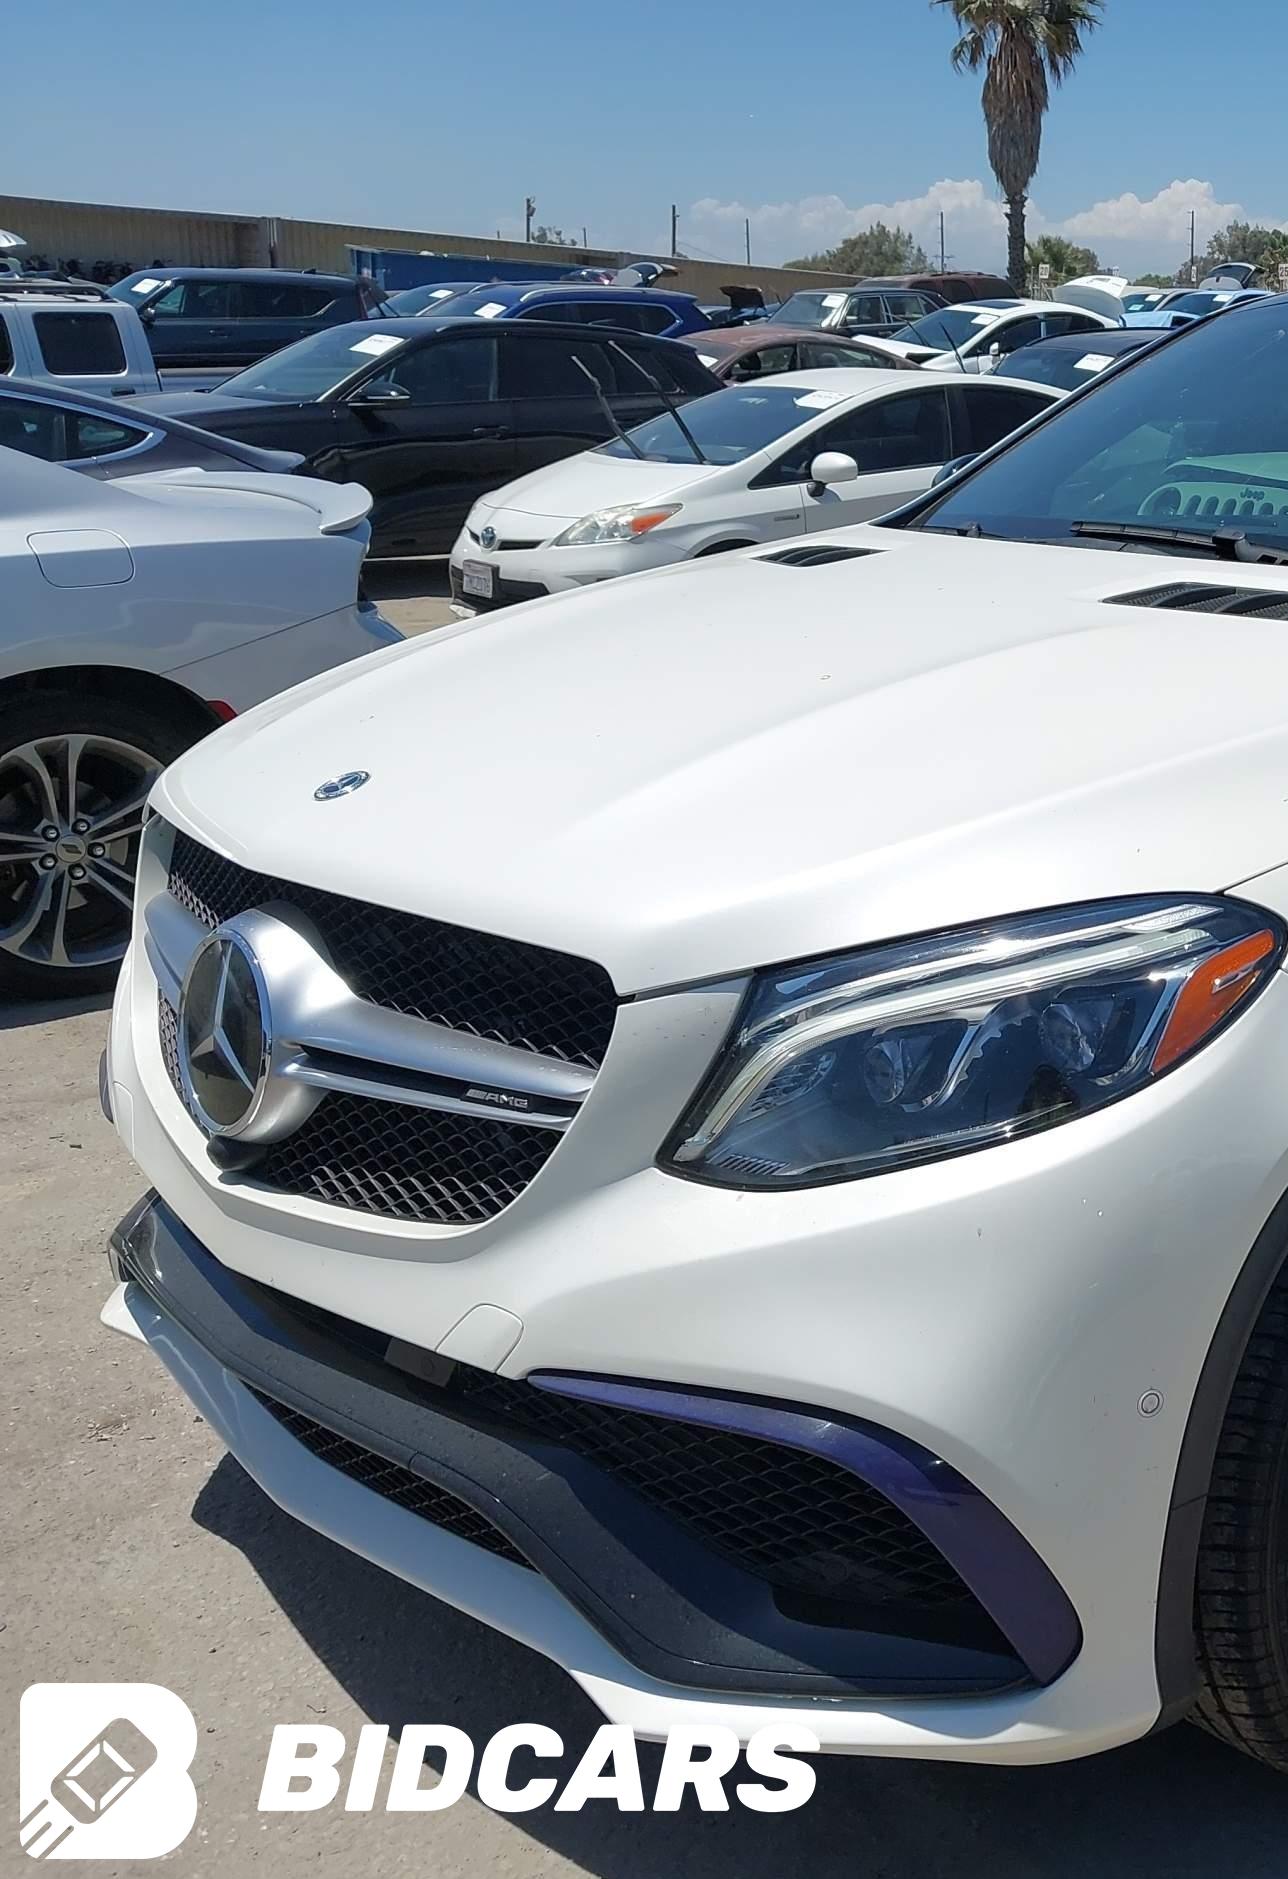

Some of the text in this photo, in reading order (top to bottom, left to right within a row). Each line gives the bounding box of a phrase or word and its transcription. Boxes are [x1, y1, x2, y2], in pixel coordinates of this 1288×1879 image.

[1279, 267, 1288, 277] 25
[1240, 488, 1265, 501] Jeep
[485, 1092, 529, 1109] AMG
